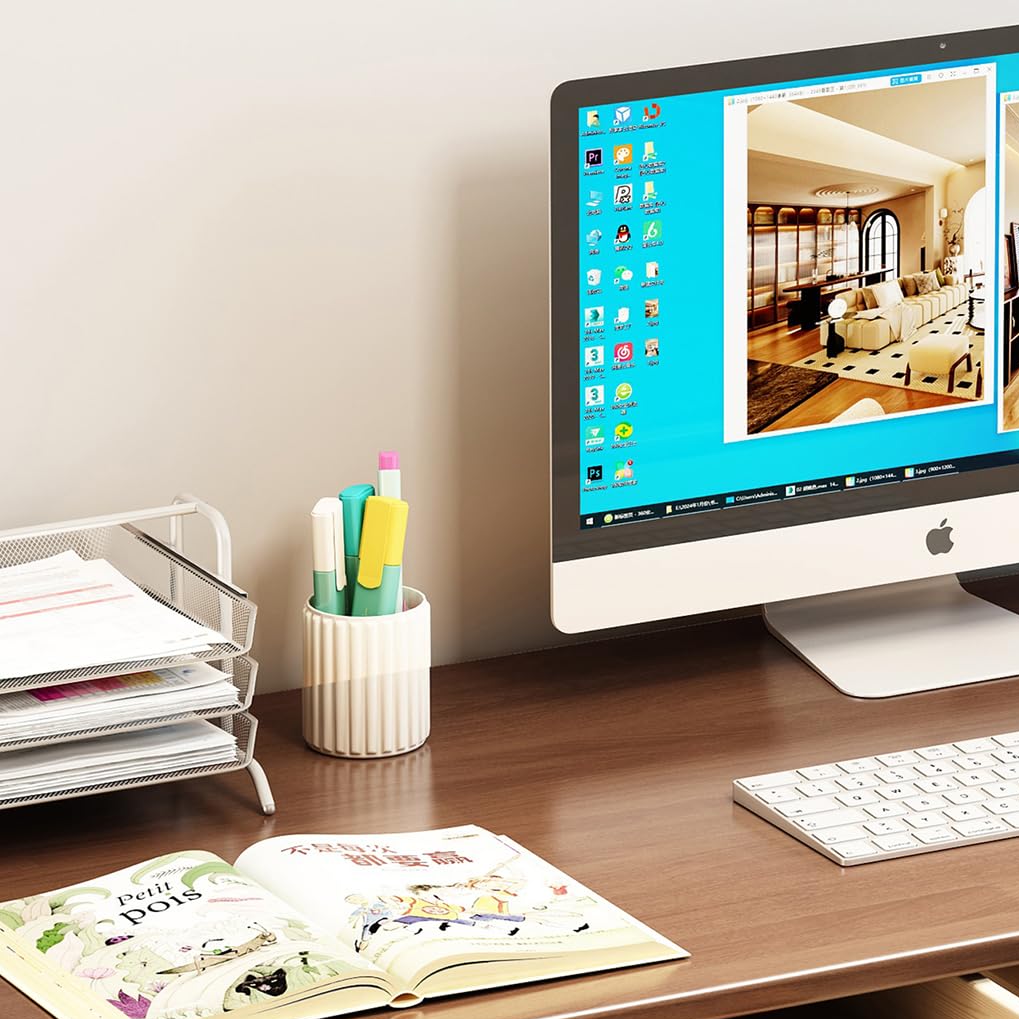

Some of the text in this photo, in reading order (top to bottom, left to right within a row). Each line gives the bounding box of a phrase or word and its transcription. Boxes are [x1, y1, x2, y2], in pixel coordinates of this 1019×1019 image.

[589, 469, 600, 478] Ps
[341, 851, 473, 867] 都要赢
[116, 882, 173, 907] Petit
[119, 889, 203, 926] pois
